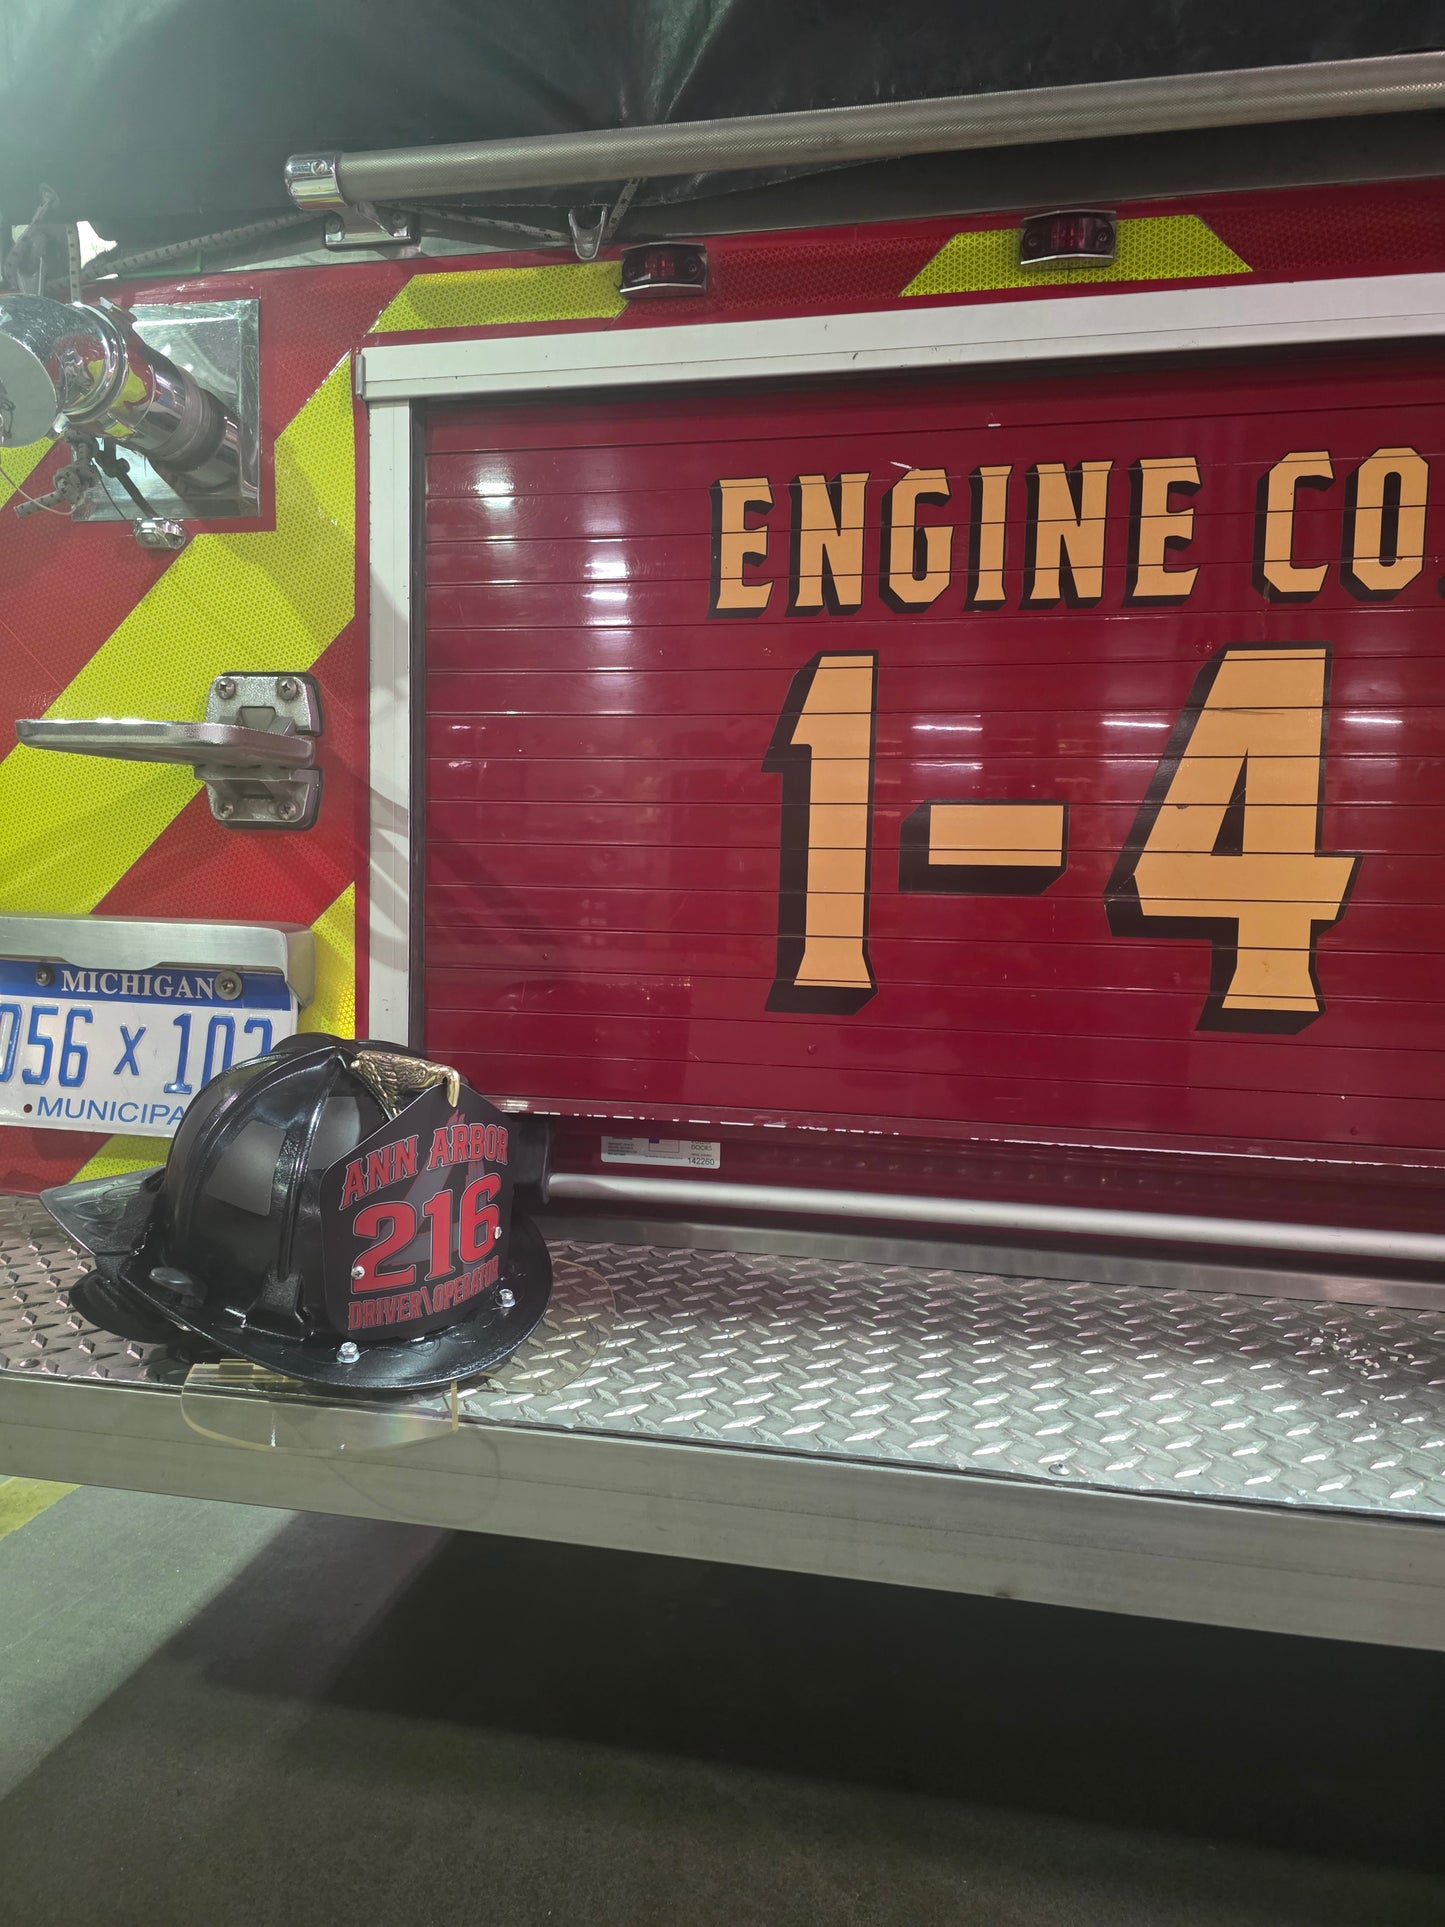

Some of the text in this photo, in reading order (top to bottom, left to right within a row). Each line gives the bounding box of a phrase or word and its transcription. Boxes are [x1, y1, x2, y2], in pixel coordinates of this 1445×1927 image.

[708, 446, 1445, 617] ENGINE CO
[762, 641, 1362, 1034] 1-4
[61, 970, 216, 1000] MICHIGAN
[113, 1025, 147, 1076] X
[339, 1123, 509, 1211] ANN ARBOR
[688, 1157, 715, 1166] 142260
[351, 1173, 502, 1294] 216
